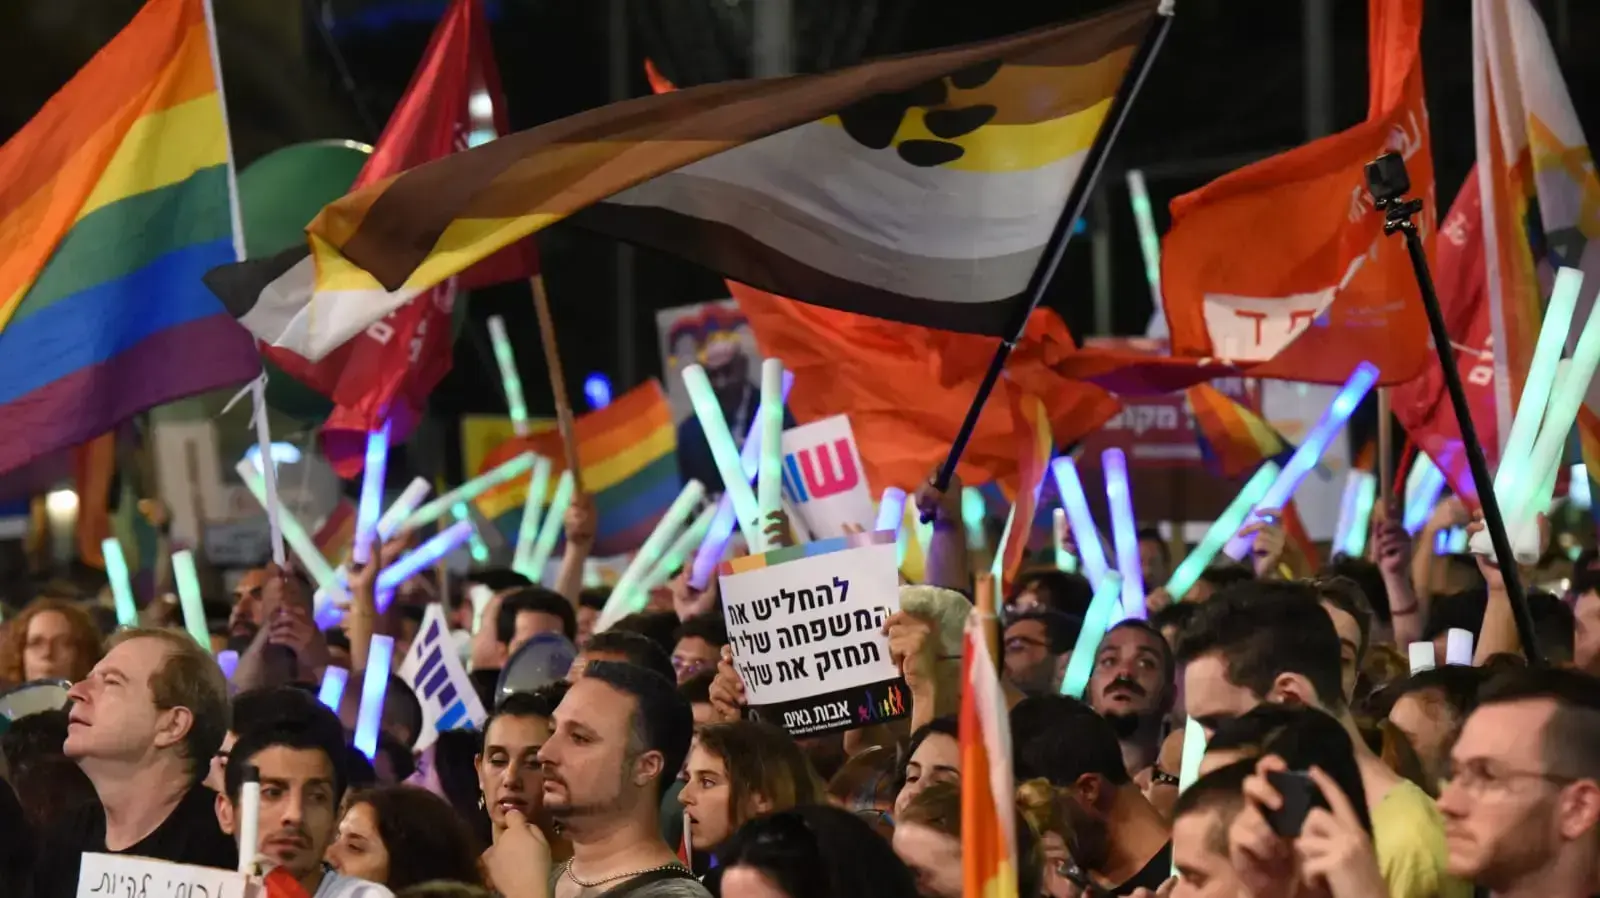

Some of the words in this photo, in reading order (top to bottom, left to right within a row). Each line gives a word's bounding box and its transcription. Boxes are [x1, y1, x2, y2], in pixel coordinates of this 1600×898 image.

[752, 576, 850, 621] להחליש
[727, 603, 750, 626] את
[776, 605, 892, 650] המשפחה
[739, 630, 771, 654] שלי
[776, 655, 809, 683] את
[813, 641, 881, 681] תחזק
[783, 708, 813, 728] גאים
[813, 700, 851, 723] אבות
